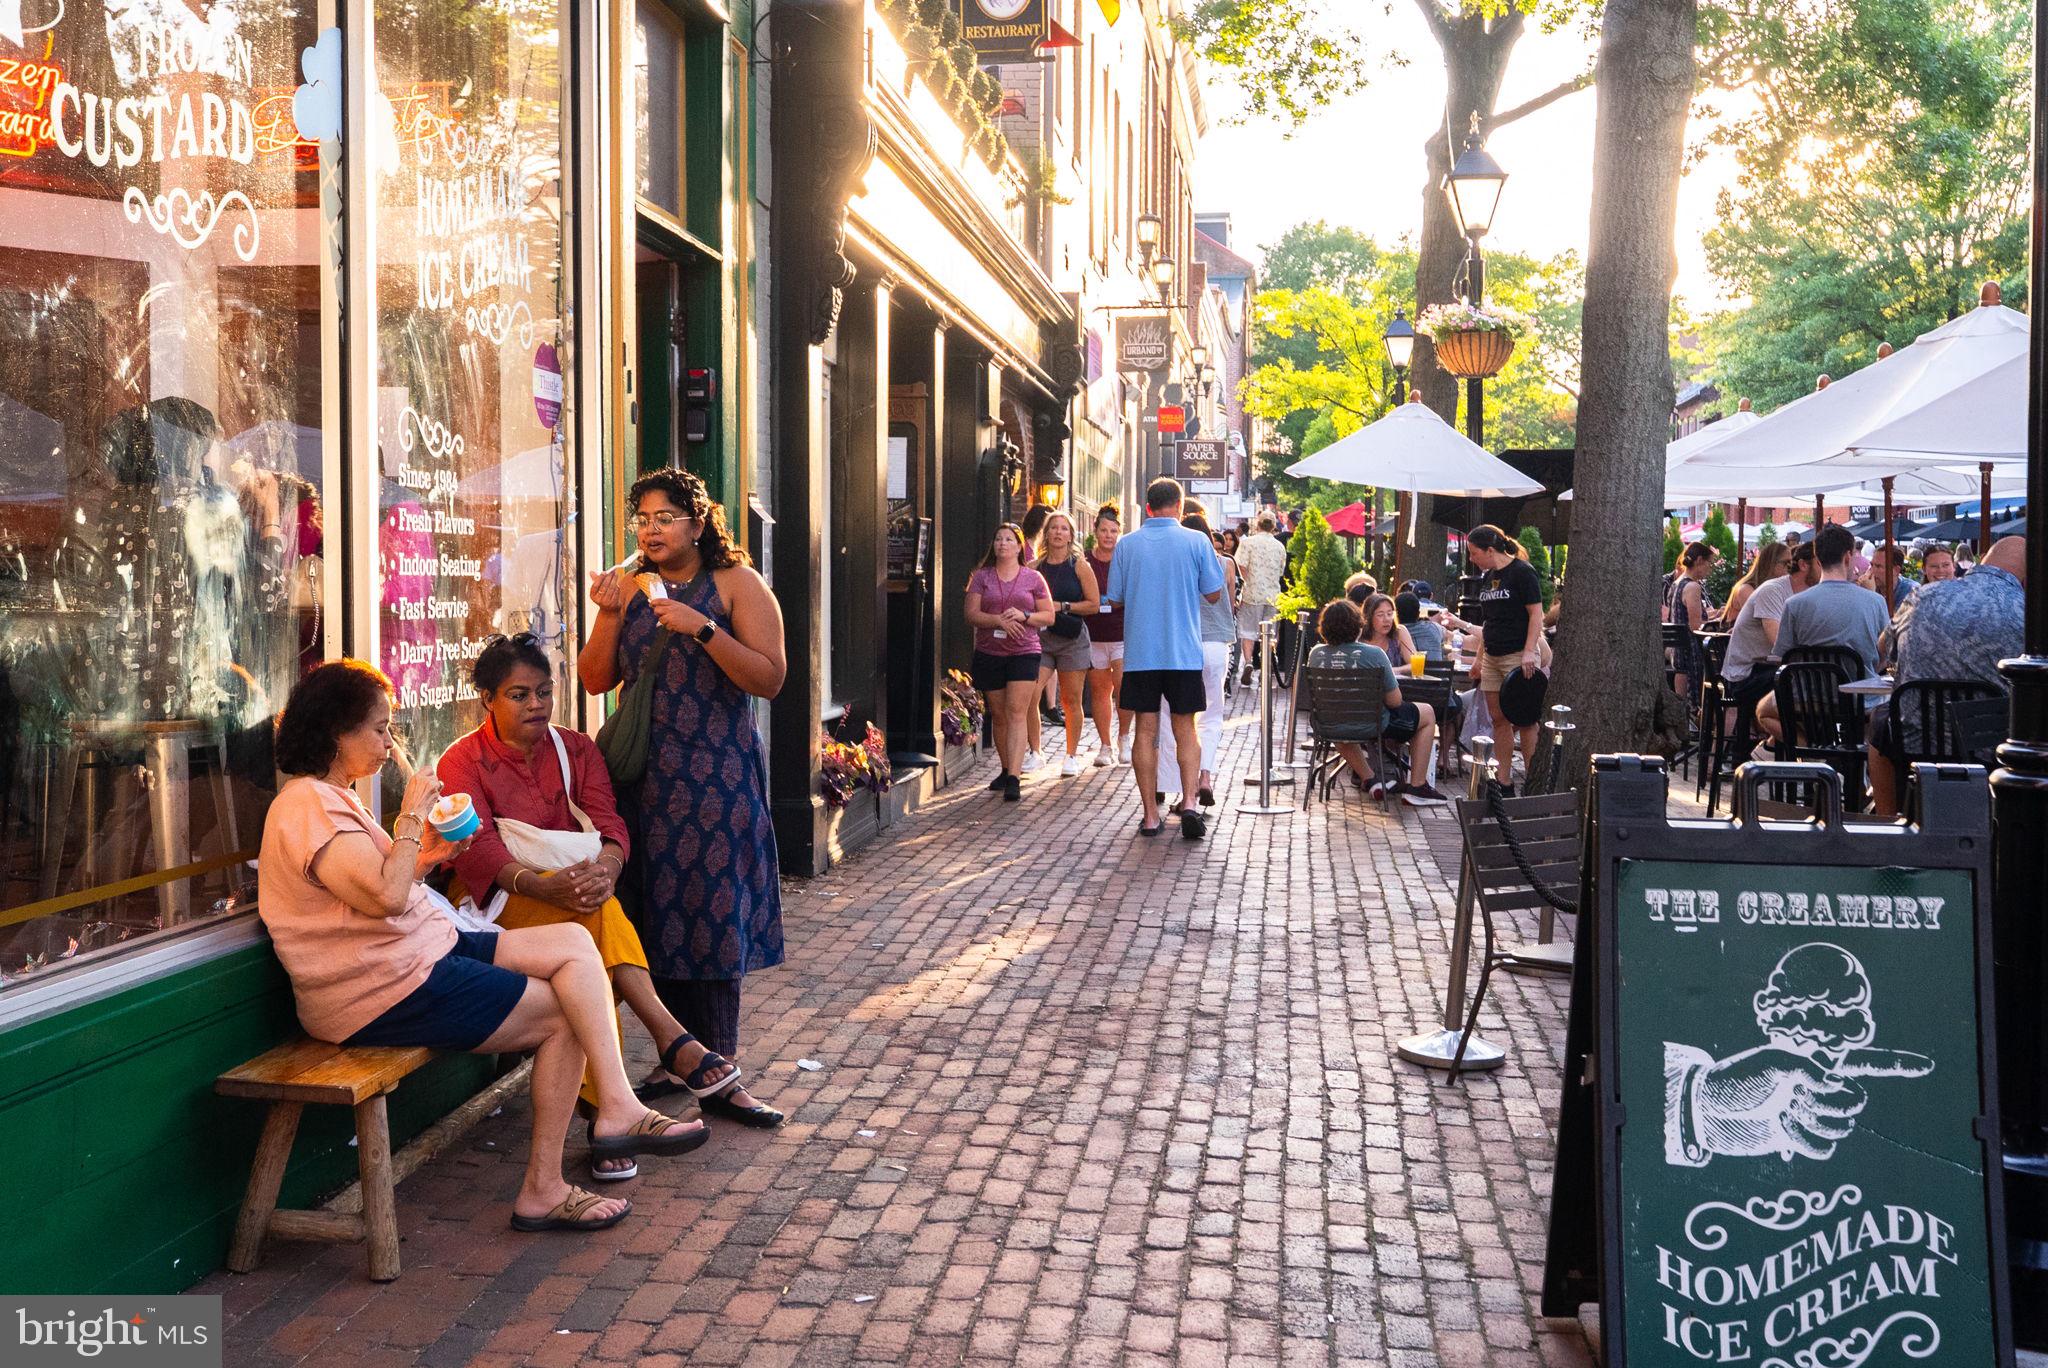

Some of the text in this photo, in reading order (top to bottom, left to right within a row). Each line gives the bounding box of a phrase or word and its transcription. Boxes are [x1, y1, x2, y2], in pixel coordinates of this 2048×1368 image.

[966, 24, 1041, 39] RESTAURANT
[138, 23, 253, 88] FRON
[50, 82, 253, 169] CUSTARD
[416, 165, 531, 237] HOMEMAD
[417, 232, 532, 310] ICE CREAM
[1126, 345, 1157, 356] URBANO
[1143, 415, 1158, 423] ATM
[1183, 452, 1218, 460] SOURCE
[1186, 443, 1215, 452] PAPER
[398, 463, 458, 492] Since 1984
[398, 507, 475, 536] Fresh Flavors
[398, 552, 481, 582] Indoor Seating
[398, 595, 469, 620] Fast Service
[399, 640, 434, 668] Dairy
[435, 638, 460, 661] Free
[400, 685, 418, 709] No
[420, 682, 455, 710] Sugar
[1644, 888, 1946, 930] THE CREAMERY
[1655, 1204, 1958, 1306] HOMEMADE
[1661, 1254, 1941, 1363] ICE CREAM
